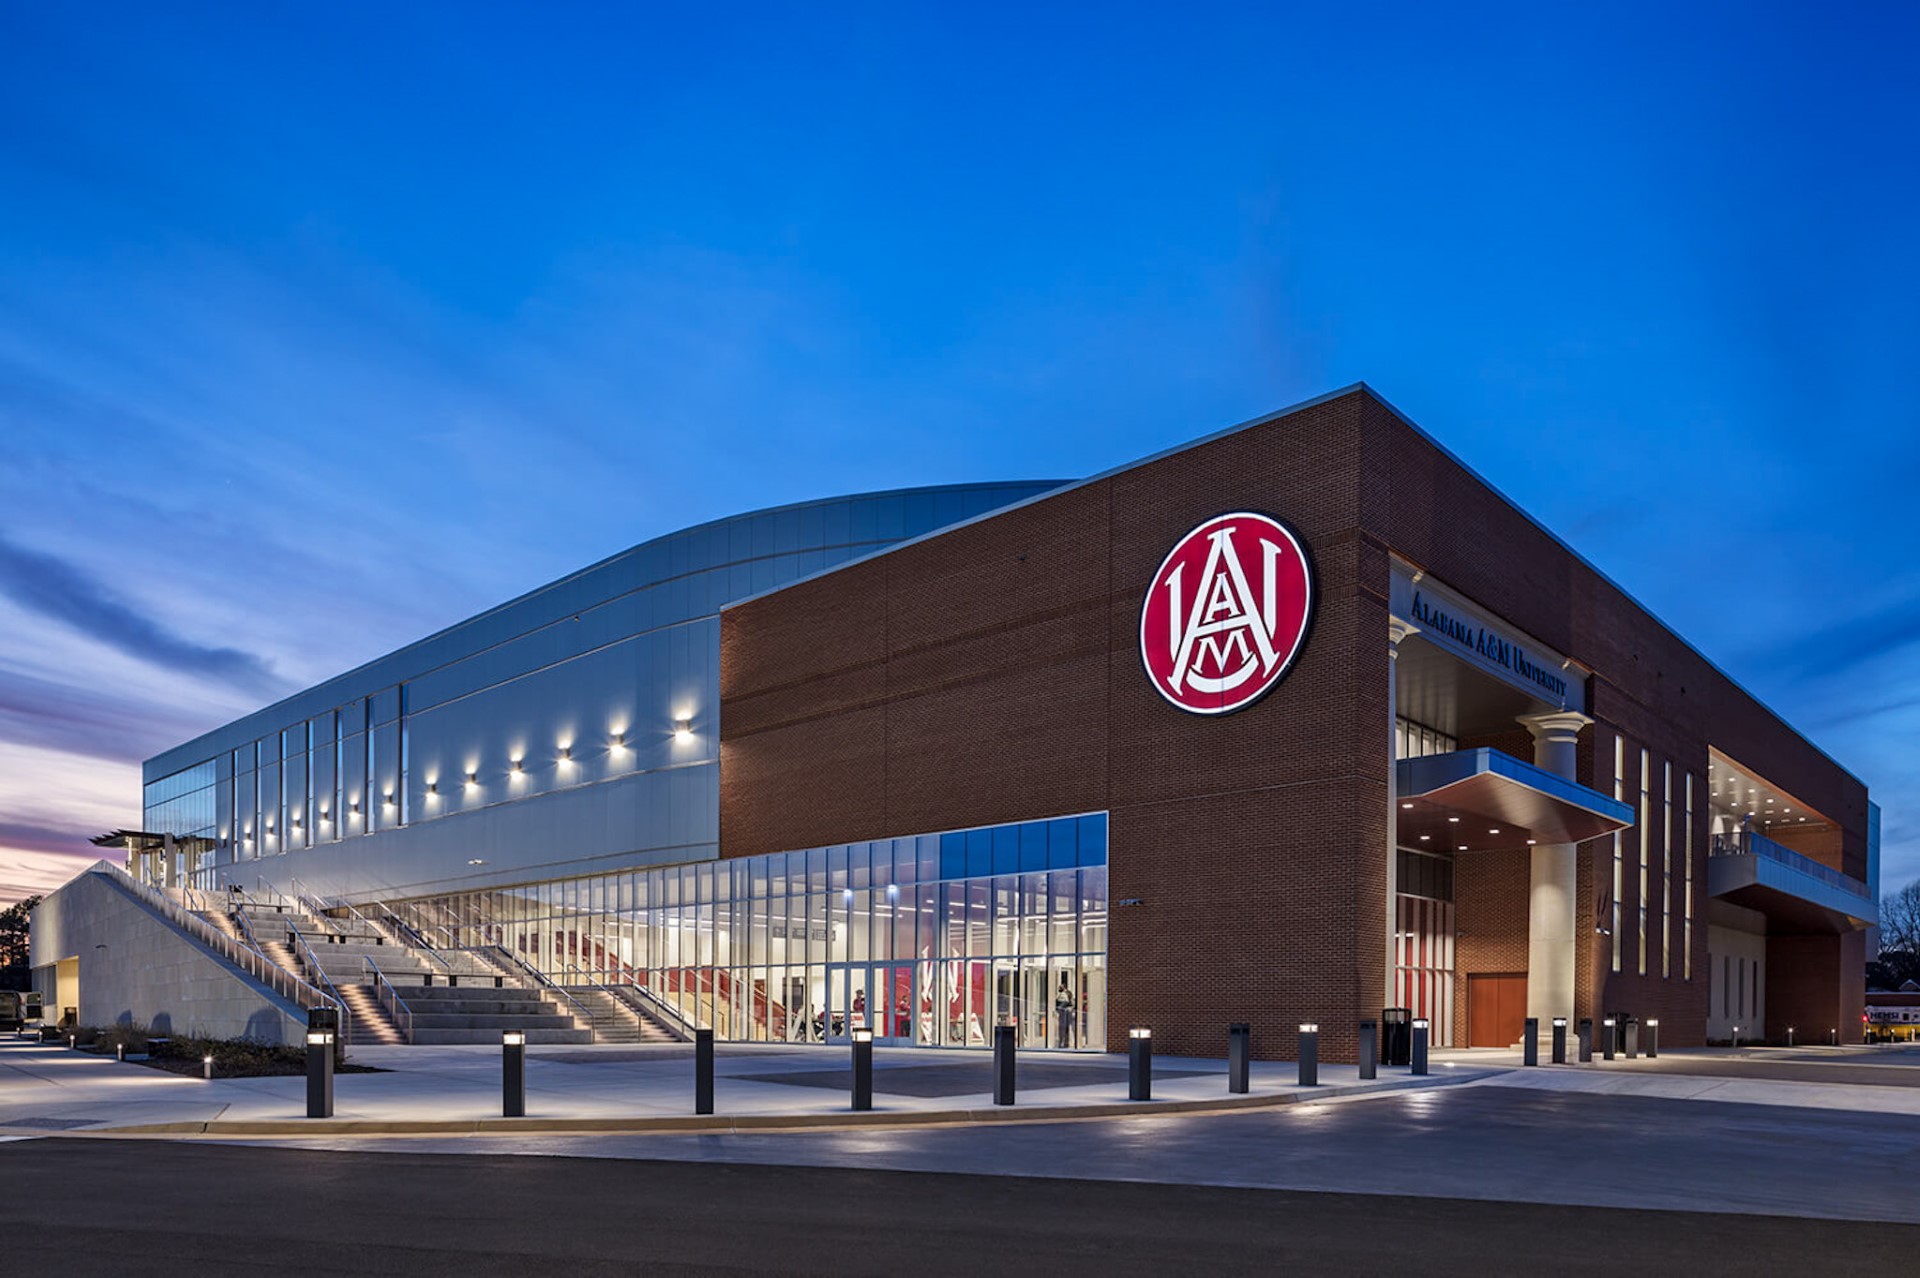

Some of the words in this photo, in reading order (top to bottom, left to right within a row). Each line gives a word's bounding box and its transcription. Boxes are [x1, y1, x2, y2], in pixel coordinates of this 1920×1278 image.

[1412, 591, 1474, 649] ALABAMA
[1476, 628, 1512, 671] A&M
[1513, 646, 1567, 697] UNIVERSITY
